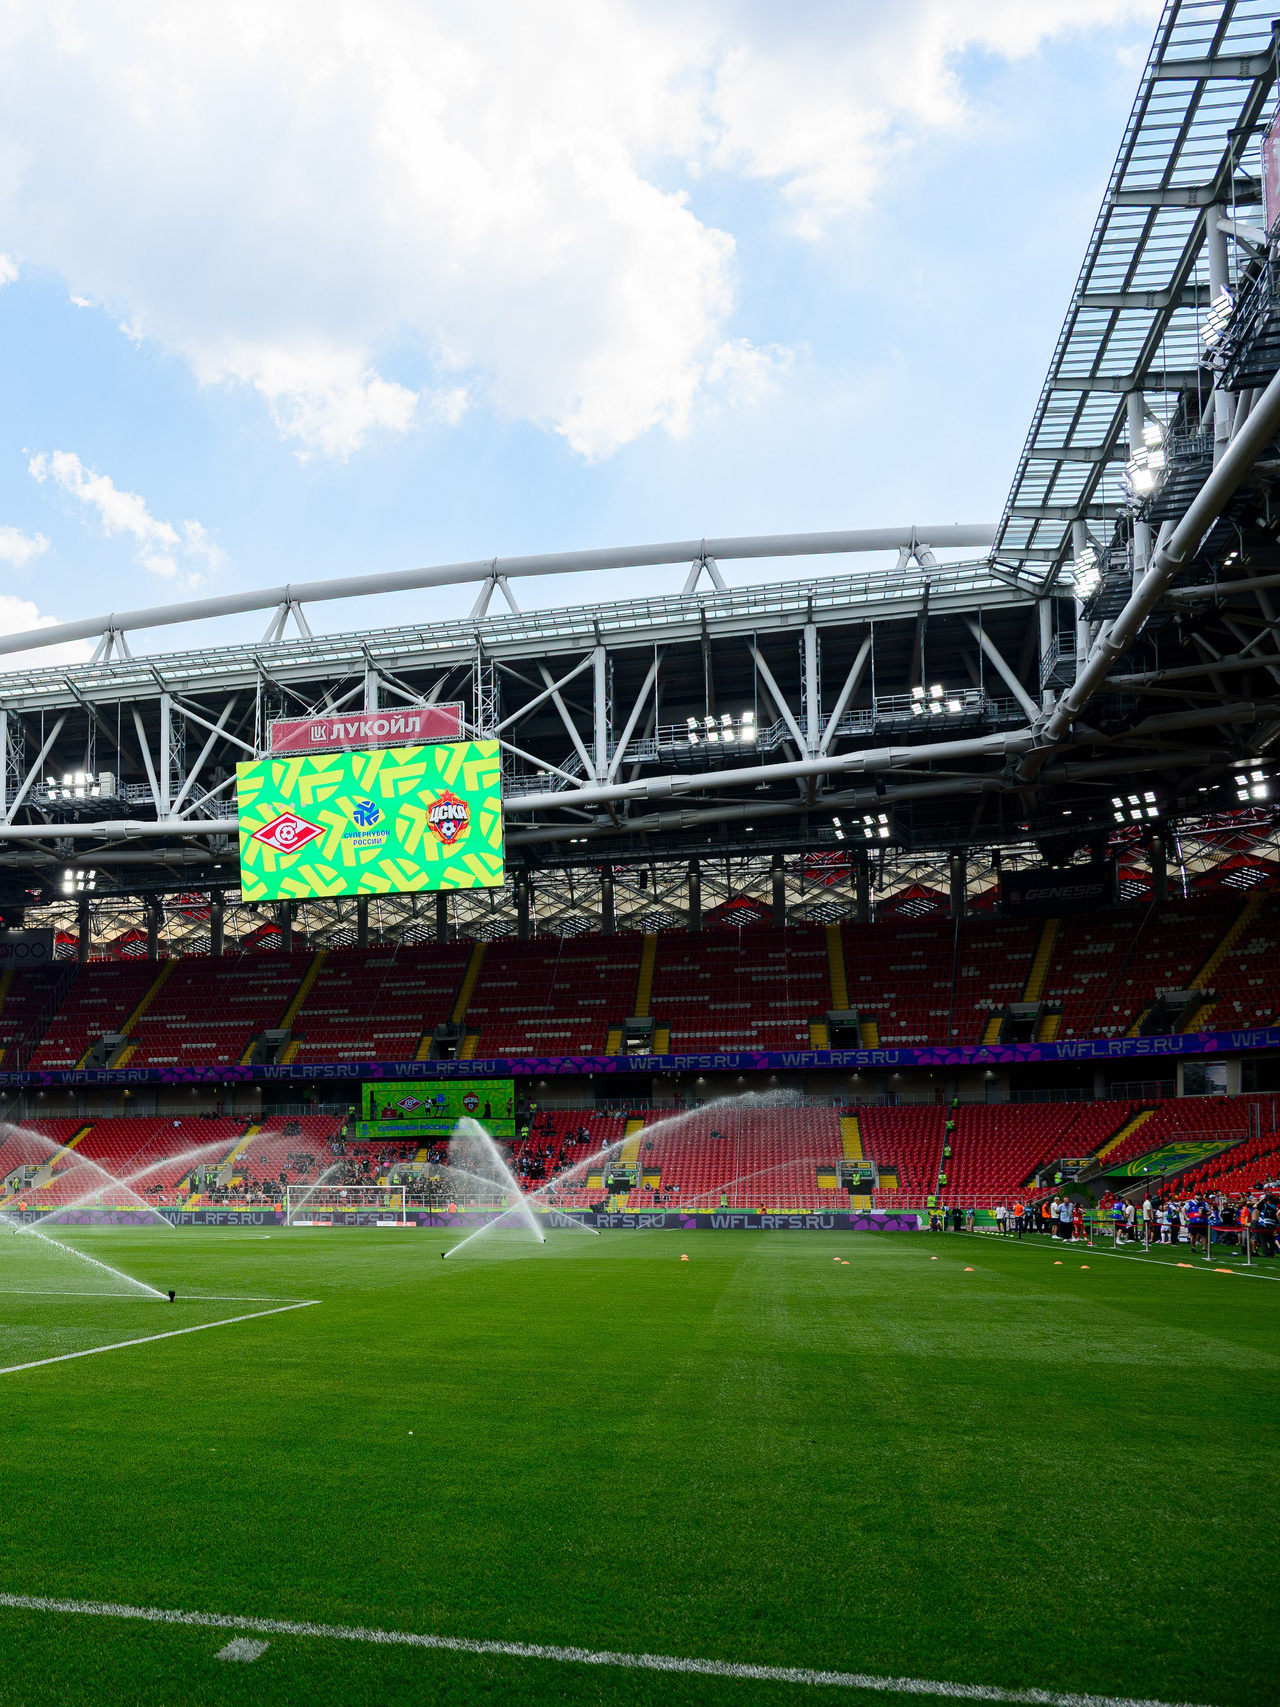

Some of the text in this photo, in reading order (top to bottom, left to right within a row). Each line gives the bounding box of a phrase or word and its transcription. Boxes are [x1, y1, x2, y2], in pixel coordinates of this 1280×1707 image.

[330, 715, 420, 740] ЛУКОЙЛ
[428, 804, 468, 823] ЦСКА
[344, 829, 391, 839] СУПЕРКУБОК
[353, 838, 382, 846] РОССИИ
[1025, 883, 1104, 900] GENESIS
[8, 942, 46, 958] 100
[1056, 1037, 1183, 1058] WFL.RFS.RU
[629, 1055, 740, 1069] WFL.RFS.RU
[782, 1051, 899, 1067] WFL.RFS.RU
[263, 1065, 359, 1078] WFL.RFS.RU
[395, 1061, 496, 1075] WFL.RFS.RU
[61, 1070, 149, 1083] WFL.RFS.RU
[165, 1212, 264, 1225] WFL.RFS.RU
[549, 1214, 666, 1228] WFL.RFS.RU
[710, 1216, 835, 1230] WFL.RFS.RU
